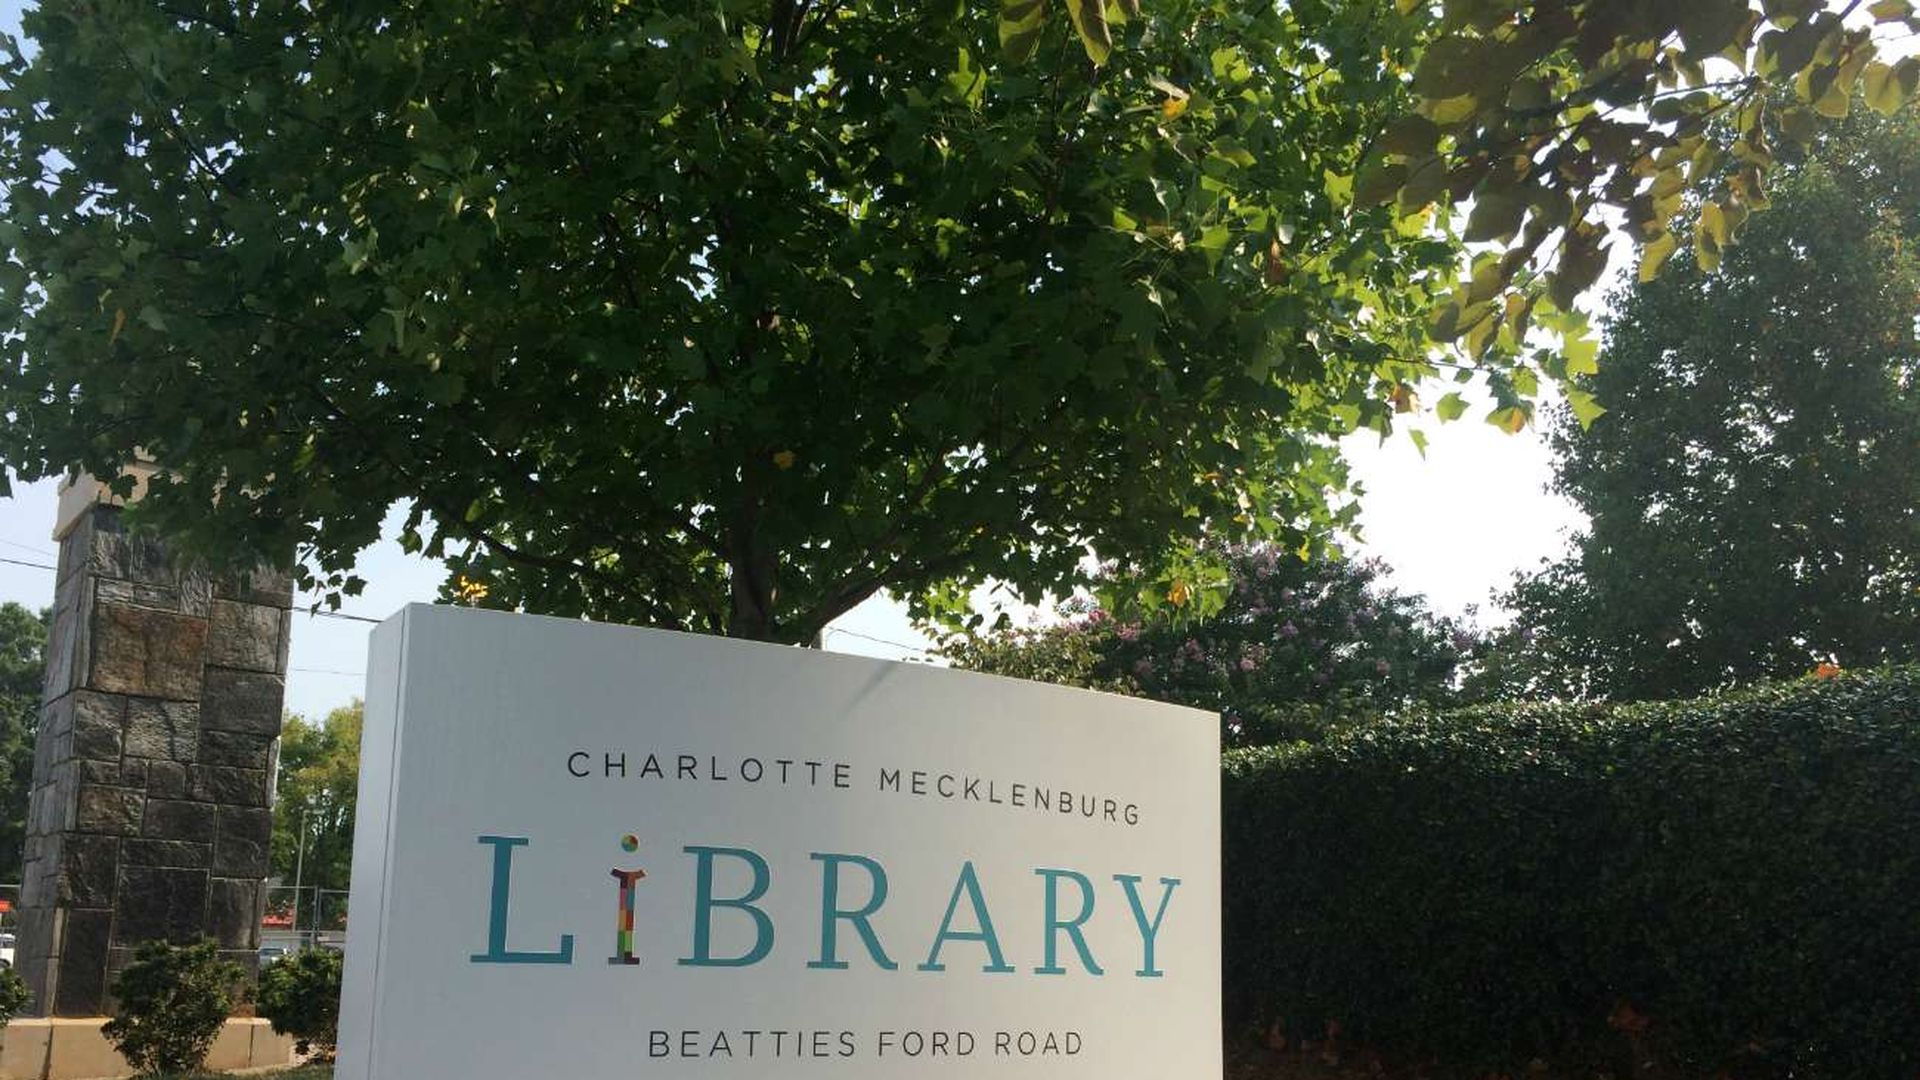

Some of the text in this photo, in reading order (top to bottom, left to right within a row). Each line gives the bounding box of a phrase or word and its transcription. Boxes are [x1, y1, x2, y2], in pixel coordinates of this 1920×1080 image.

[567, 751, 1139, 826] CHARLOTTE MECKLENBURG
[648, 1030, 1082, 1058] BEATTIES FORD ROAD
